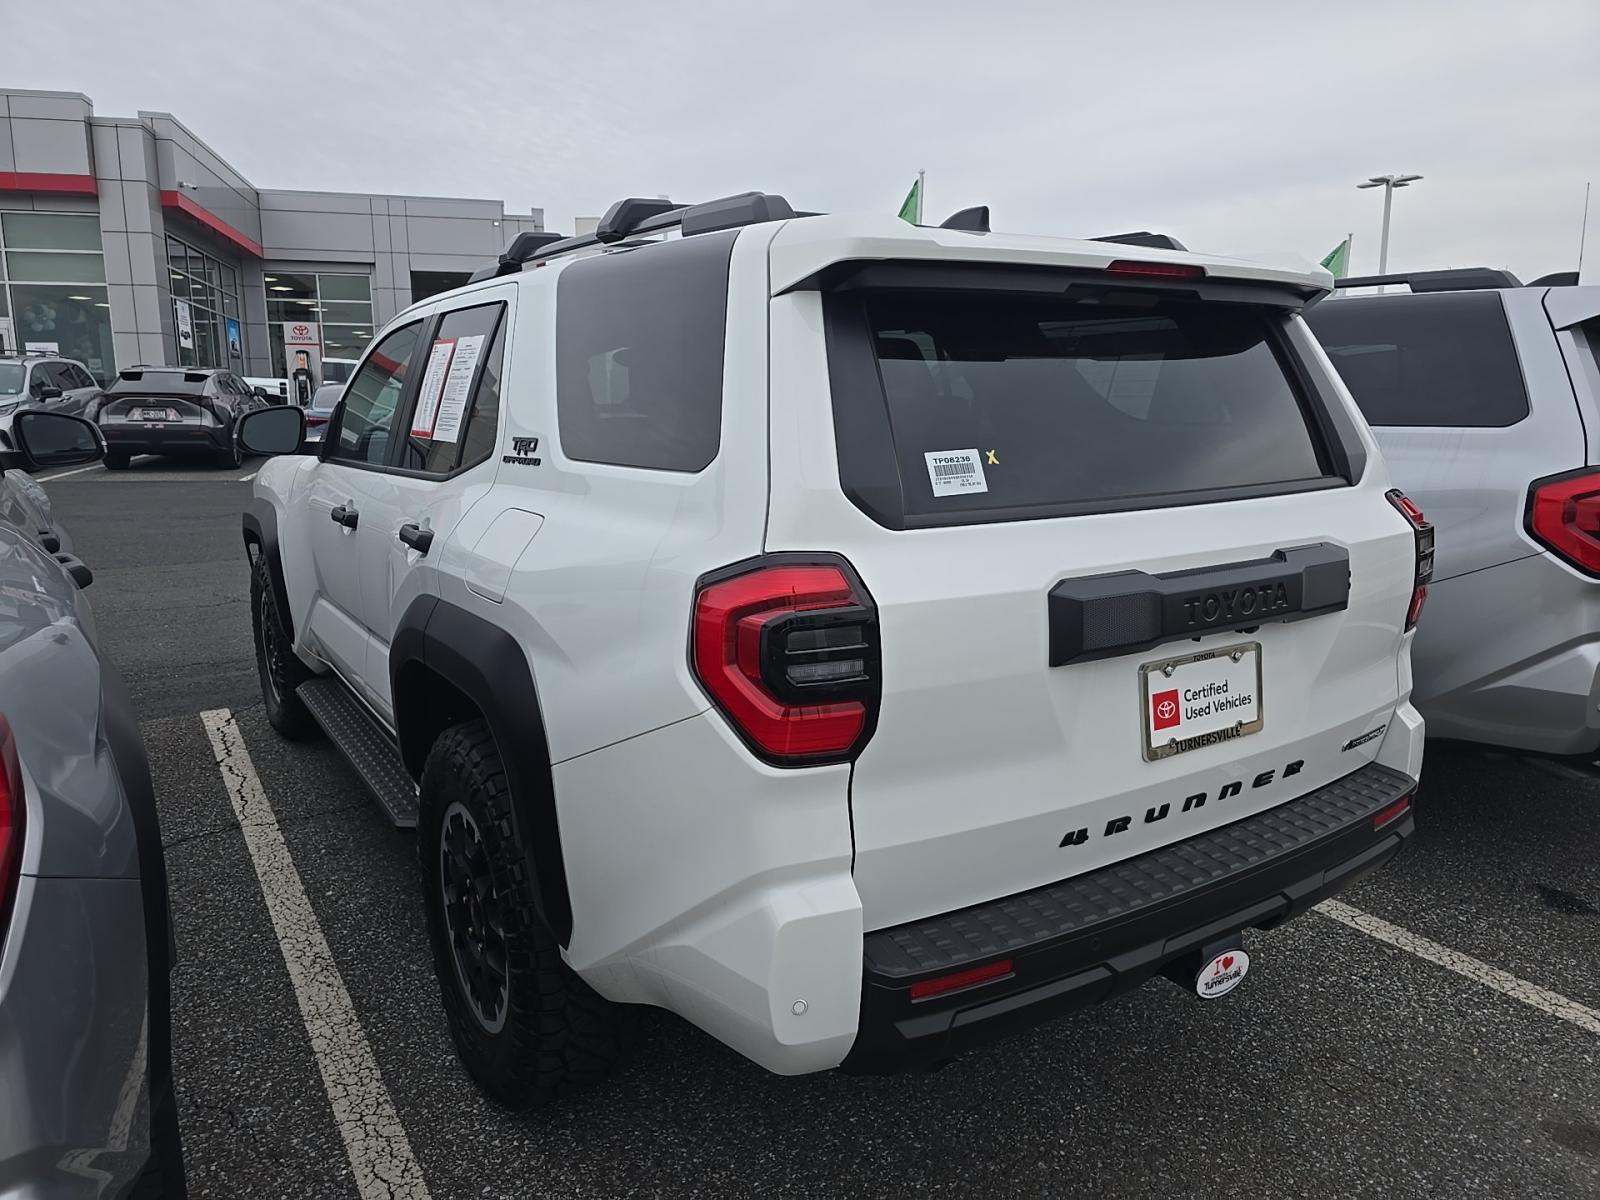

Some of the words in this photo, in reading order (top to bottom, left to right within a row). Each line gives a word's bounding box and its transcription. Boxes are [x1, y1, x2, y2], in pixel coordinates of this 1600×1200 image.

[512, 436, 539, 456] TRD
[1183, 582, 1289, 625] TOYOTA
[1193, 652, 1216, 662] TOYOTA
[1184, 680, 1229, 702] Certified
[1185, 702, 1211, 720] Used
[1213, 693, 1252, 713] Vehicles
[1175, 726, 1241, 753] TURNERSVILLE
